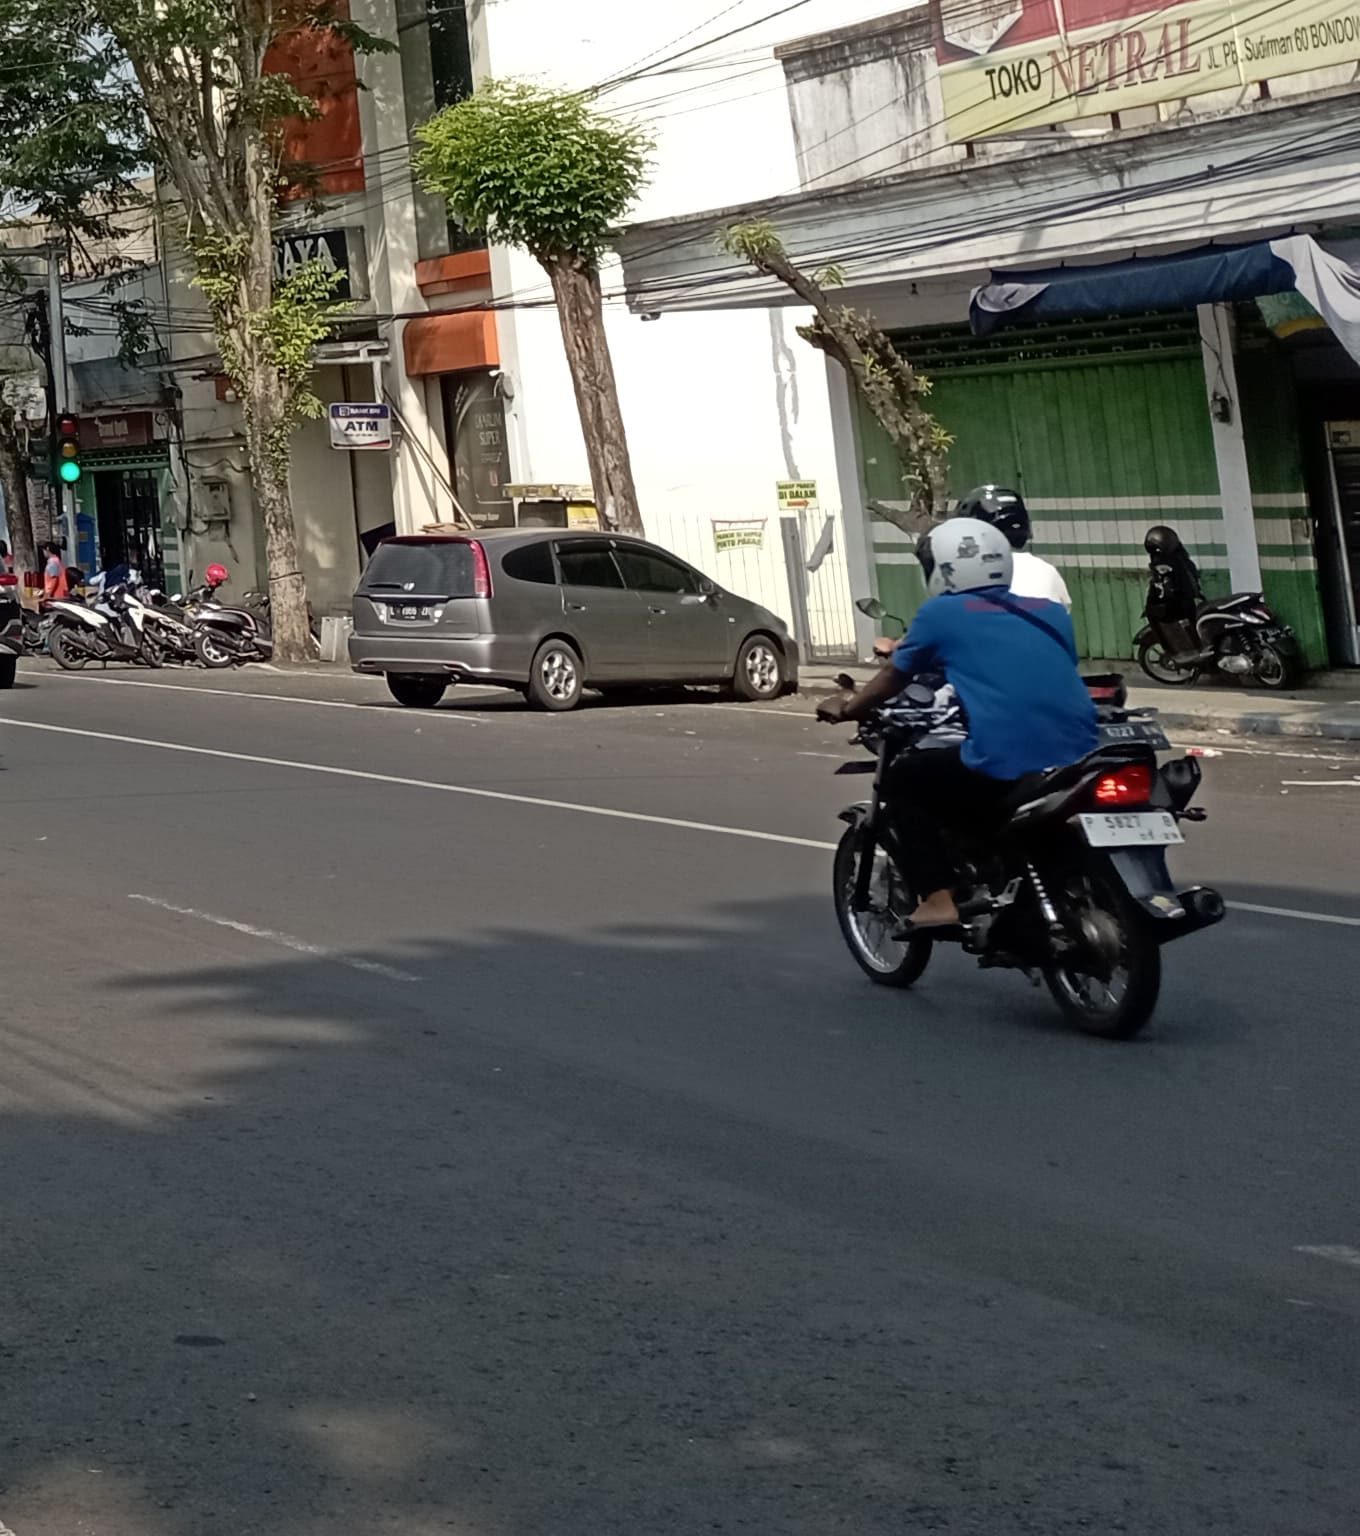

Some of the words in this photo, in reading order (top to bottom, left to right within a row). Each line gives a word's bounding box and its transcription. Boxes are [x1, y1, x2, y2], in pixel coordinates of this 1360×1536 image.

[985, 58, 1041, 101] TOKO
[1047, 17, 1201, 105] NETRAL
[1244, 33, 1294, 62] Sudirman
[1294, 27, 1309, 52] 60
[344, 421, 378, 431] ATM
